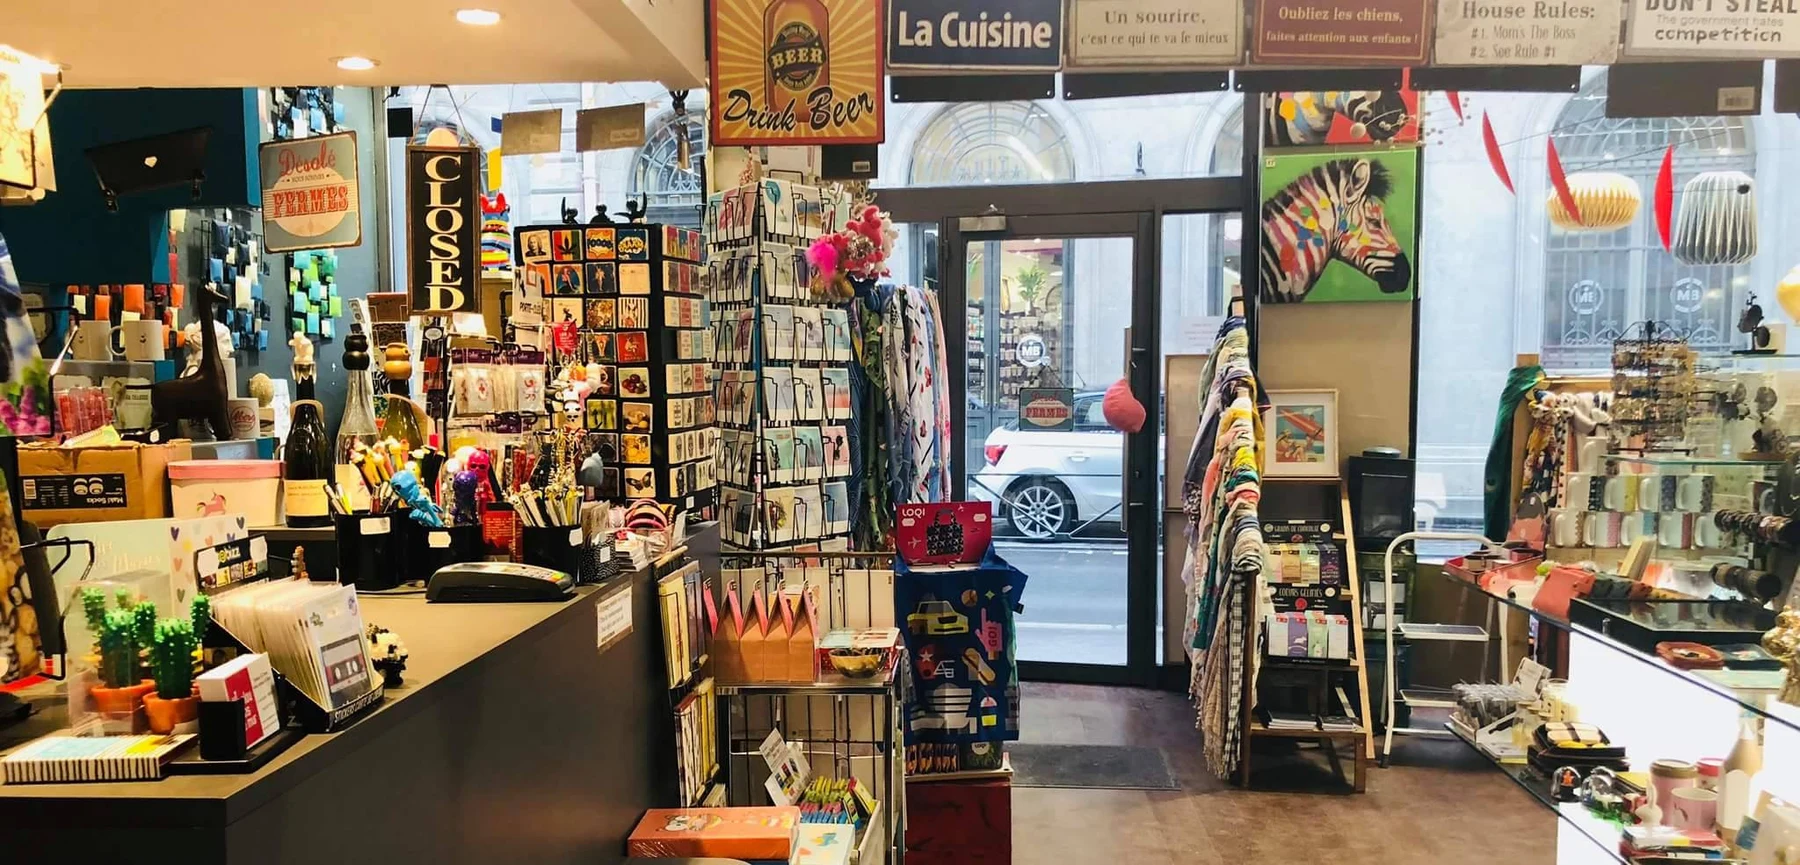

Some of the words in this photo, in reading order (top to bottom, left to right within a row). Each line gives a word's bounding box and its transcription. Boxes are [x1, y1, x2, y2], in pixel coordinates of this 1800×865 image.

[1104, 10, 1128, 24] Un
[1135, 9, 1206, 24] sourire,
[1279, 6, 1329, 21] Oubliez
[1334, 7, 1352, 21] les
[1356, 7, 1403, 22] chiens,
[1462, 0, 1526, 19] House
[1533, 0, 1596, 19] Rules:
[1656, 14, 1677, 25] The
[1680, 16, 1749, 27] government
[1752, 16, 1784, 27] hates
[898, 11, 933, 47] La
[940, 11, 1052, 48] Cuisine
[1266, 30, 1295, 43] faites
[1298, 32, 1346, 43] attention
[1349, 34, 1369, 43] aux
[1371, 32, 1412, 44] enfants
[1493, 24, 1526, 40] Mom's
[1530, 24, 1549, 40] The
[1553, 25, 1576, 40] Boss
[1654, 26, 1782, 45] competition
[1081, 32, 1107, 46] c'est
[1111, 34, 1124, 45] ce
[1128, 32, 1146, 47] qui
[1149, 32, 1160, 44] te
[1164, 34, 1177, 44] va
[1195, 32, 1229, 44] mieux
[771, 47, 823, 70] BEER
[1492, 45, 1511, 59] See
[1514, 44, 1538, 59] Rule
[1543, 46, 1557, 59] #1
[723, 89, 797, 132] Drink
[806, 85, 874, 131] Beer
[278, 140, 336, 177] Désolé
[272, 185, 349, 219] FERMES
[424, 155, 465, 312] CLOSED
[1021, 345, 1042, 356] MB
[86, 496, 106, 504] Socks
[901, 507, 926, 519] LOQI
[987, 625, 998, 647] GO!
